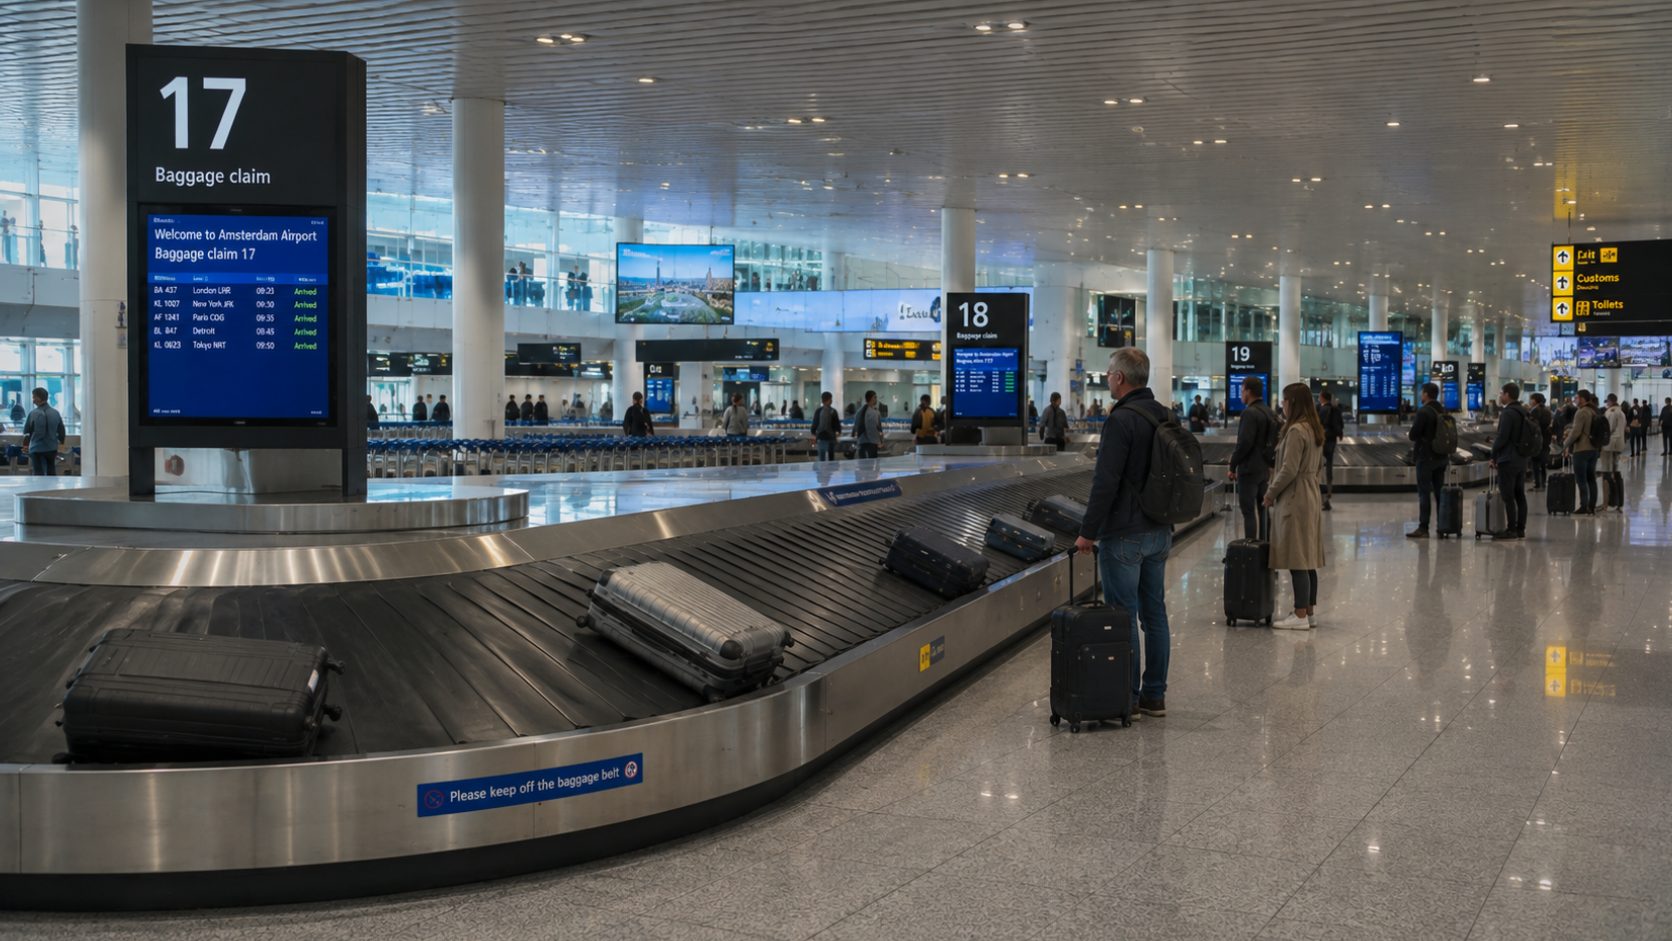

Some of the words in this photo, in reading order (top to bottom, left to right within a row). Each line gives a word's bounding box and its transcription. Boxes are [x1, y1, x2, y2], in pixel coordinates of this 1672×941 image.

[160, 77, 246, 149] 17
[156, 167, 224, 186] Baggage
[230, 168, 270, 183] claim
[155, 229, 202, 240] Welcome
[205, 230, 215, 240] to
[219, 229, 277, 240] Amsterdam
[281, 229, 316, 244] Airport
[156, 247, 204, 262] Baggage
[208, 248, 237, 259] claim
[242, 248, 255, 259] 17
[1577, 274, 1619, 283] Customs
[193, 287, 216, 295] London
[959, 302, 988, 327] 18
[1232, 347, 1250, 361] 19
[451, 790, 486, 802] Please
[490, 787, 516, 797] keep
[520, 781, 534, 793] off
[538, 779, 554, 790] the
[558, 773, 599, 788] baggage
[602, 768, 619, 780] belt
